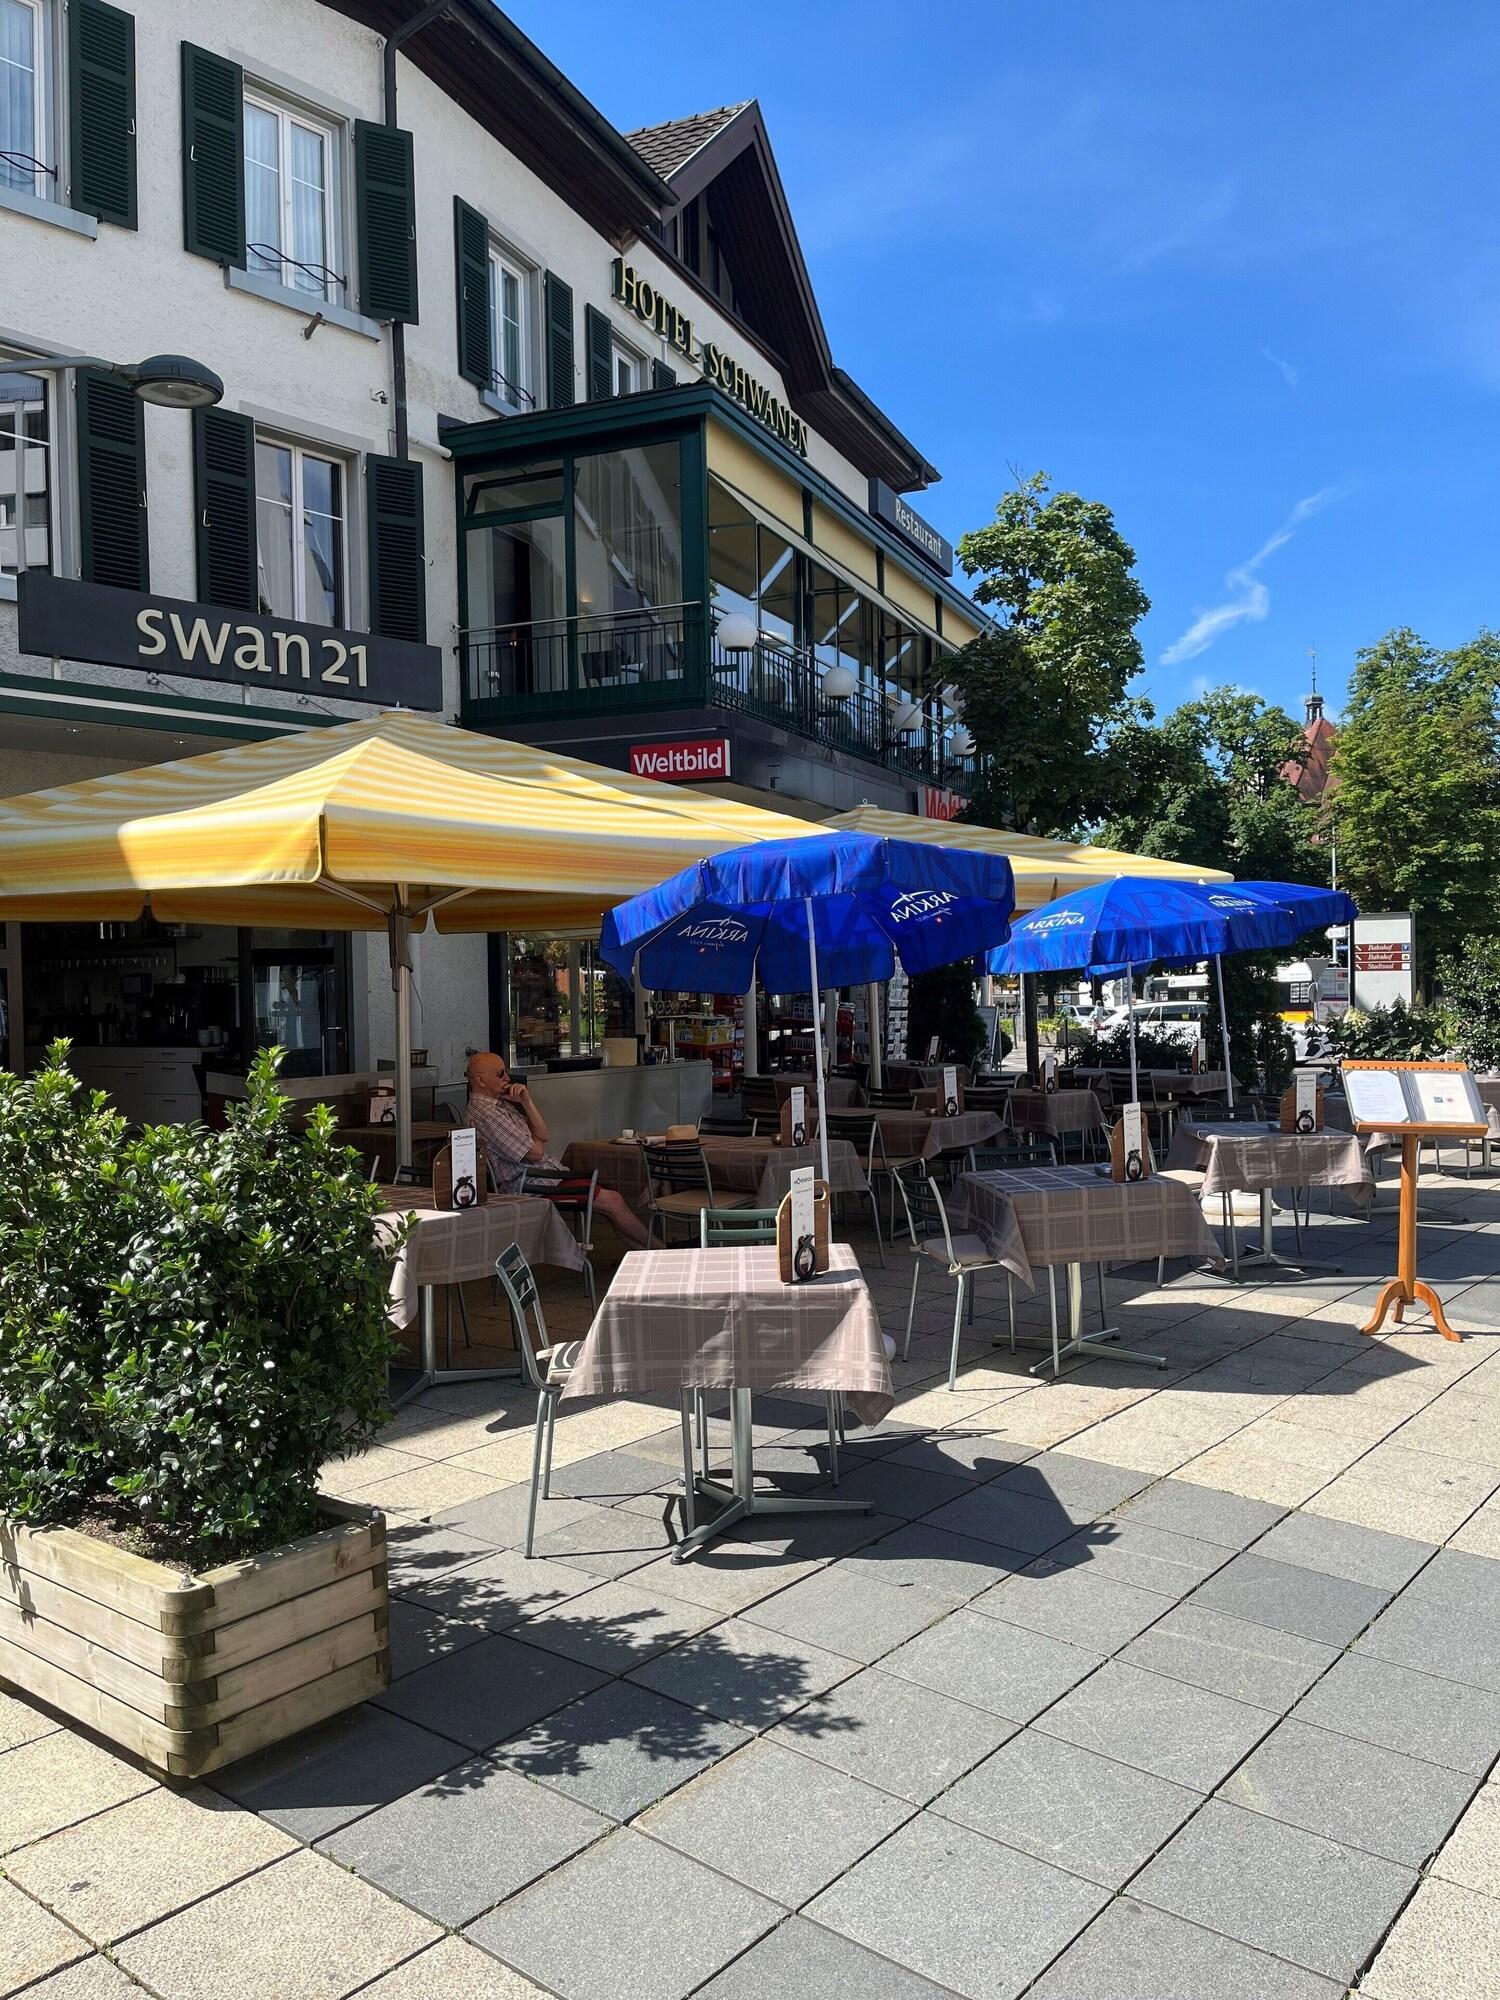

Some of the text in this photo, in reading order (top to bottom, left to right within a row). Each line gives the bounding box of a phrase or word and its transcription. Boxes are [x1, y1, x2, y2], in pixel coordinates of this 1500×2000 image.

[612, 257, 809, 457] HOTEL SCHWANEN
[895, 497, 942, 559] Restaurant
[633, 746, 722, 775] Weltbild
[1022, 915, 1085, 931] ARKINA
[1367, 943, 1393, 952] Bahnhof
[1367, 953, 1393, 961] Bahnhof
